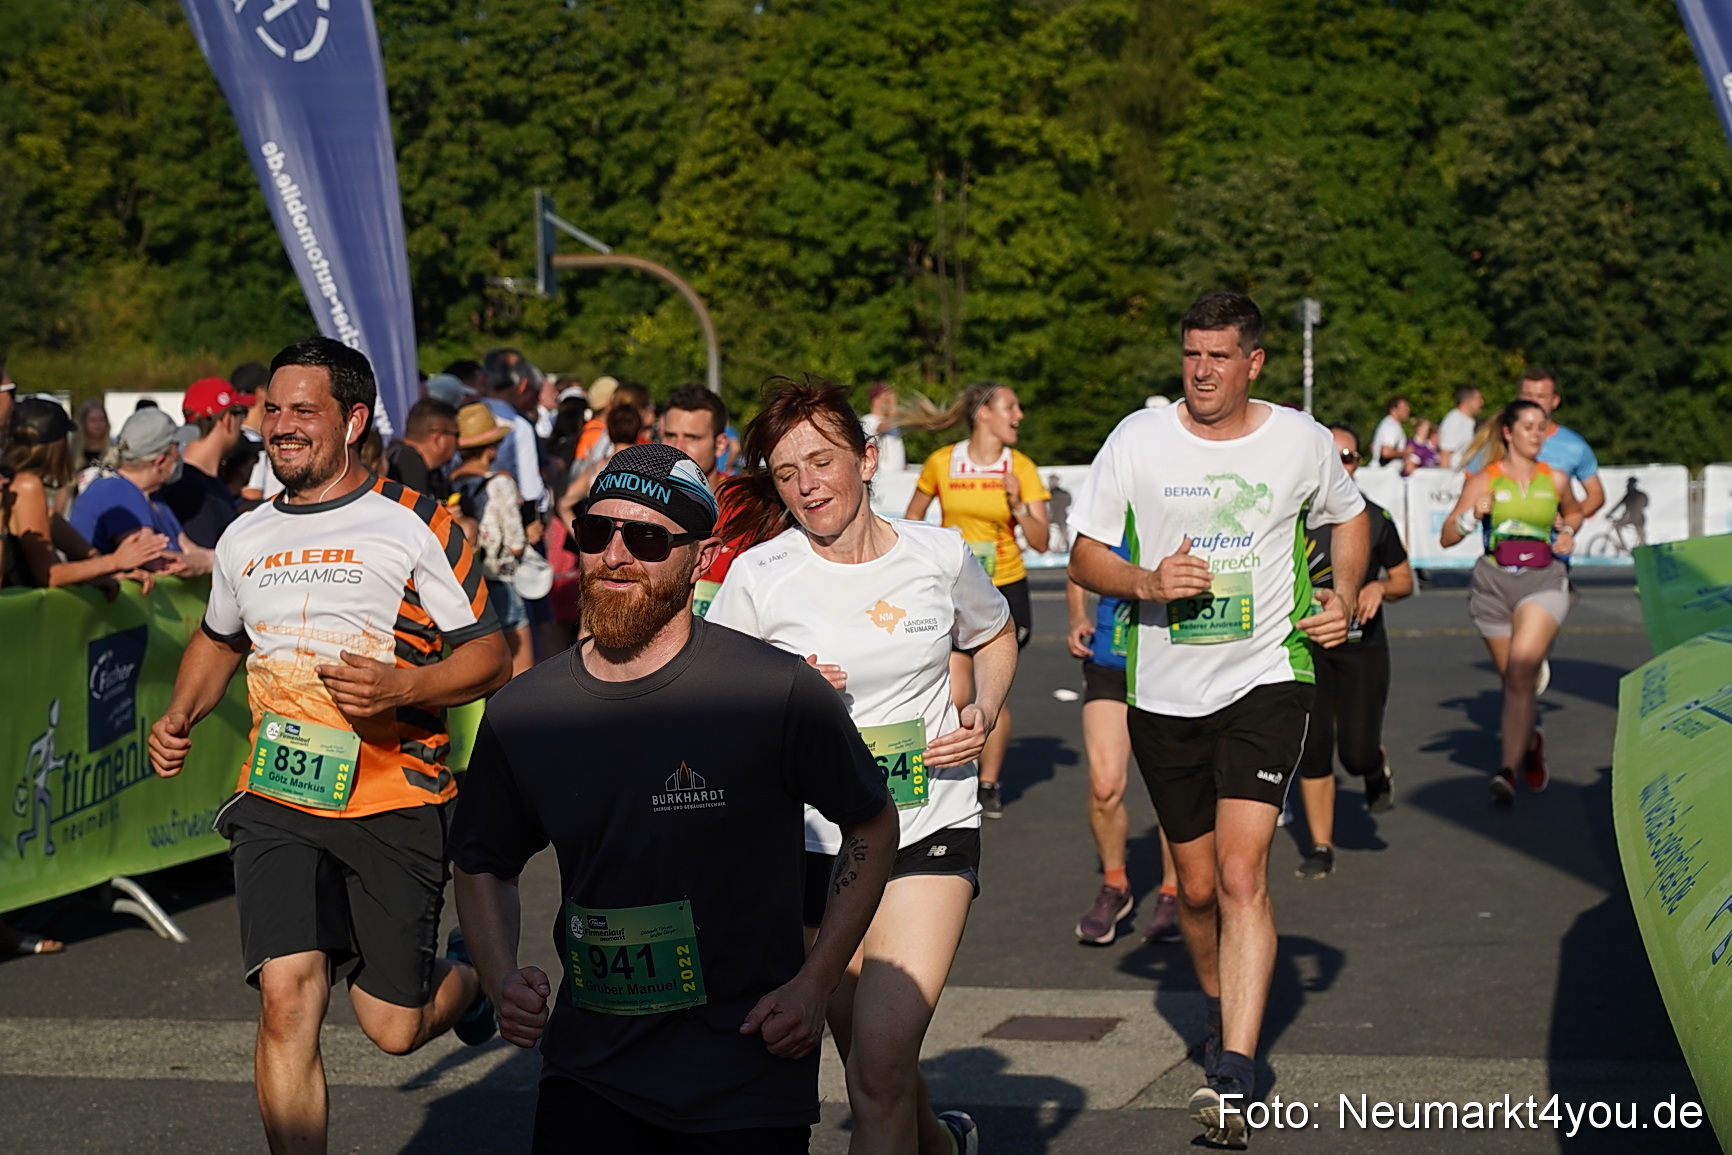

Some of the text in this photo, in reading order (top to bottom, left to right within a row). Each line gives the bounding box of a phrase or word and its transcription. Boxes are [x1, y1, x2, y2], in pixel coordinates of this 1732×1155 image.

[596, 472, 672, 504] XINTOWN
[1164, 487, 1211, 497] BERATA
[265, 549, 364, 569] KLEBL
[768, 551, 788, 563] JAKO
[1207, 551, 1261, 572] lgreich
[259, 568, 364, 588] DYNAMICS
[879, 612, 894, 622] NM
[1186, 597, 1230, 620] 357
[1241, 597, 1251, 630] 2022
[903, 617, 938, 627] LANDKREIS
[904, 624, 939, 634] NEUMARKT
[63, 717, 153, 816] firmenl
[255, 747, 267, 776] RUN
[274, 745, 325, 780] 831
[269, 772, 288, 785] Götz
[290, 778, 326, 793] Markus
[333, 763, 350, 800] 2022
[912, 754, 924, 795] 2022
[652, 789, 725, 806] BURKHARDT
[584, 928, 625, 937] Firmenlauf
[571, 951, 584, 988] RUN
[588, 944, 656, 980] 941
[677, 944, 696, 993] 2022
[585, 979, 678, 996] Gruber Manuel
